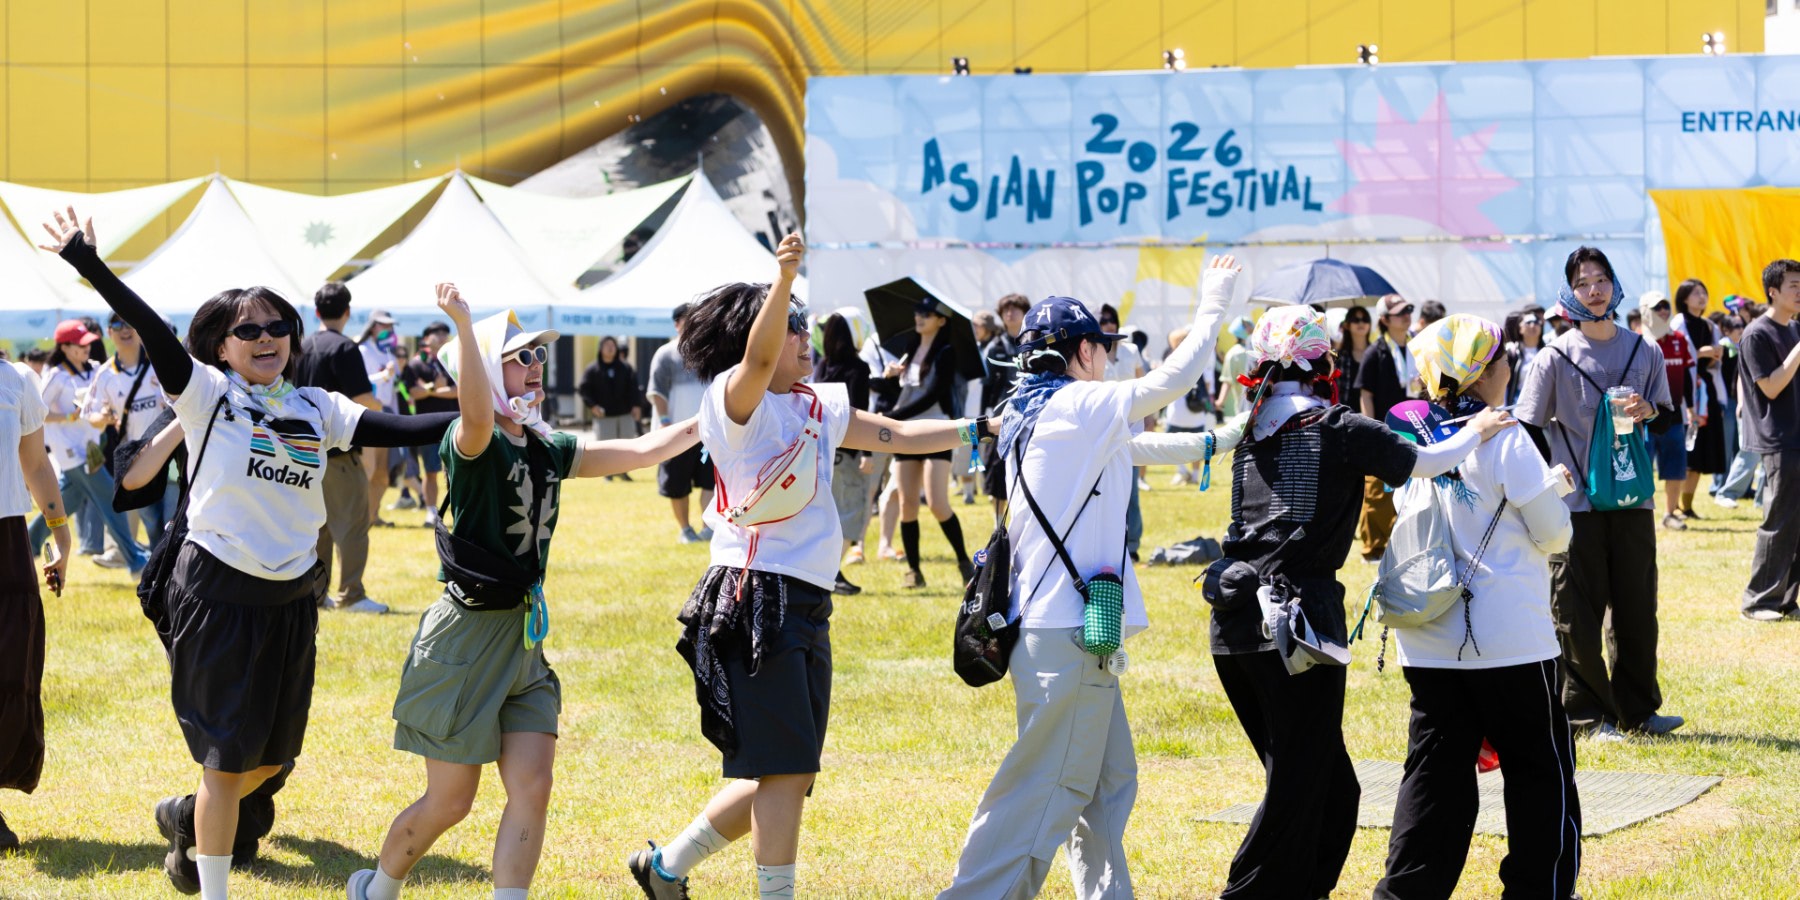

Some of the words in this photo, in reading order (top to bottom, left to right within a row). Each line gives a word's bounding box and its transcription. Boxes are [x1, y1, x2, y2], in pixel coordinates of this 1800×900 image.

[1085, 113, 1243, 174] 2026
[921, 137, 1056, 224] ASIAN
[1166, 165, 1323, 222] FESTIVAL
[247, 457, 314, 489] Kodak
